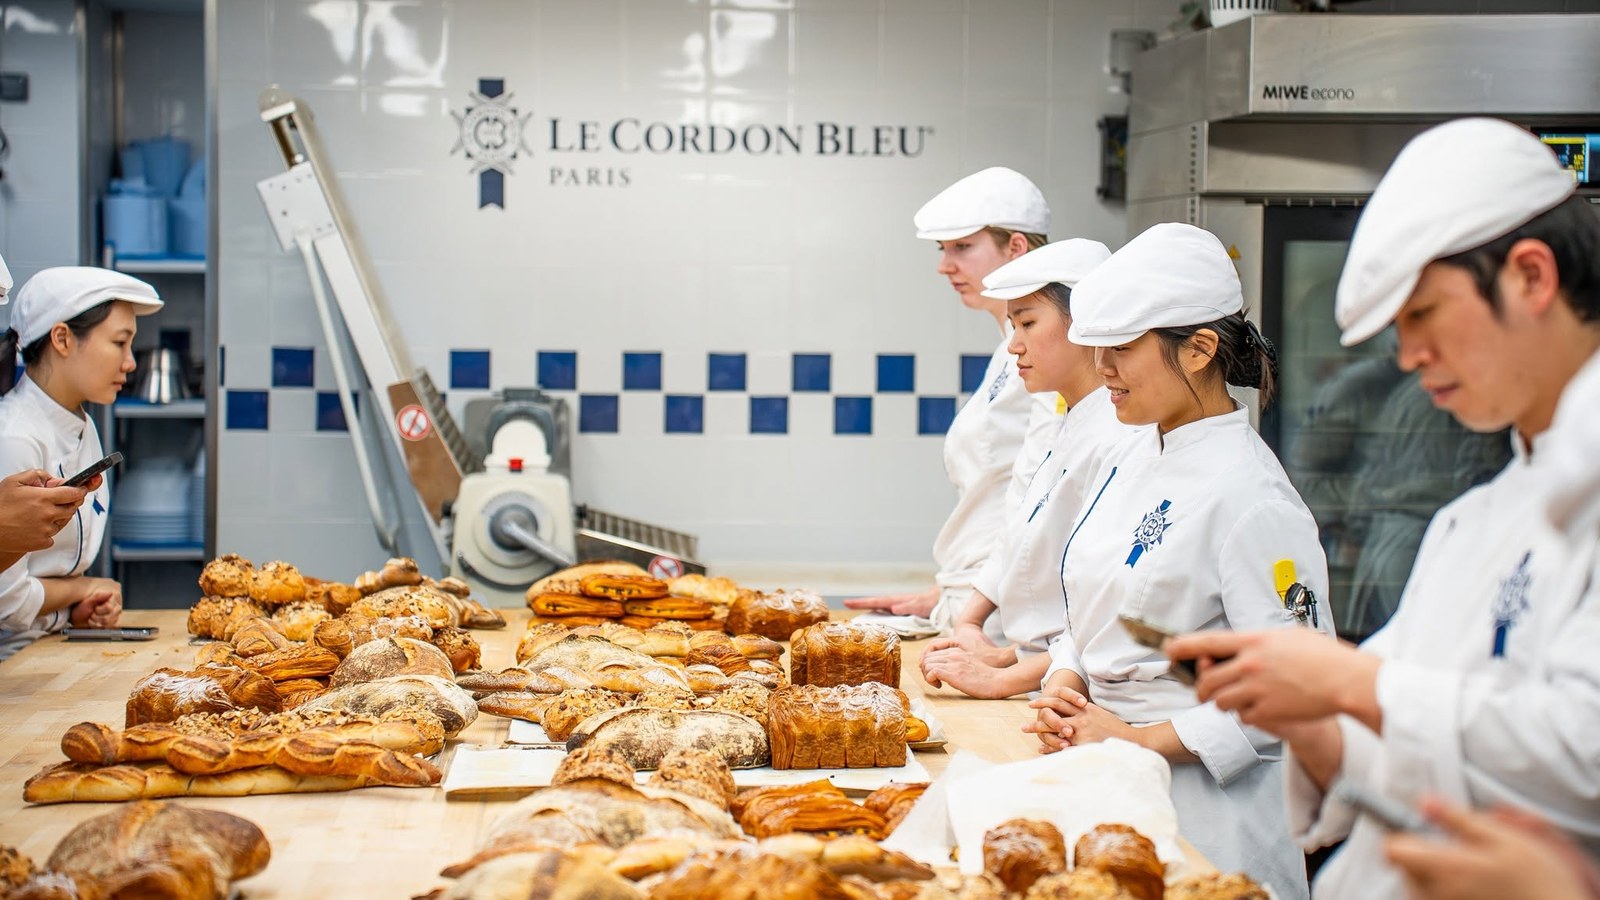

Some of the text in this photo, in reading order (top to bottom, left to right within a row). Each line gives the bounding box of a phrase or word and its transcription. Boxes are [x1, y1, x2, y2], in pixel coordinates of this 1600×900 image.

[1262, 84, 1355, 101] MIWE econo
[548, 116, 601, 152] LE
[608, 117, 805, 156] CORDON
[816, 121, 925, 158] BLEU
[549, 166, 631, 188] PARIS
